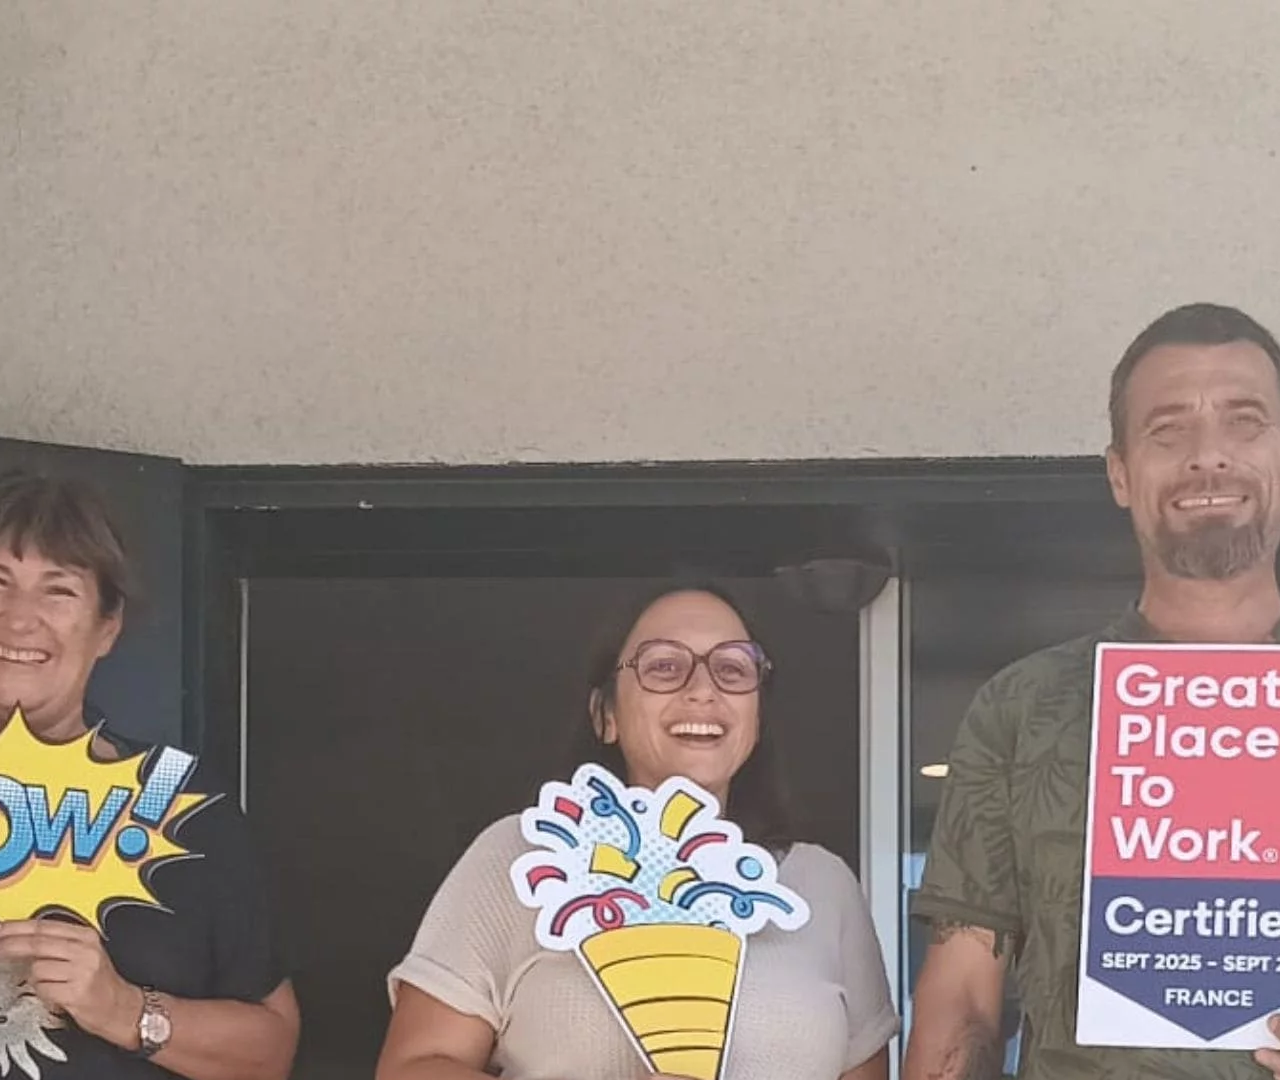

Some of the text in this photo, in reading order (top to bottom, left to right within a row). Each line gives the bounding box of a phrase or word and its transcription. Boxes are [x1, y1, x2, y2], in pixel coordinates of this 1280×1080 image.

[1117, 713, 1280, 759] Place
[1111, 765, 1175, 808] To
[1101, 953, 1150, 970] SEPT
[1153, 954, 1202, 971] 2025
[1222, 955, 1272, 973] SEPT
[1164, 988, 1254, 1008] FRANCE
